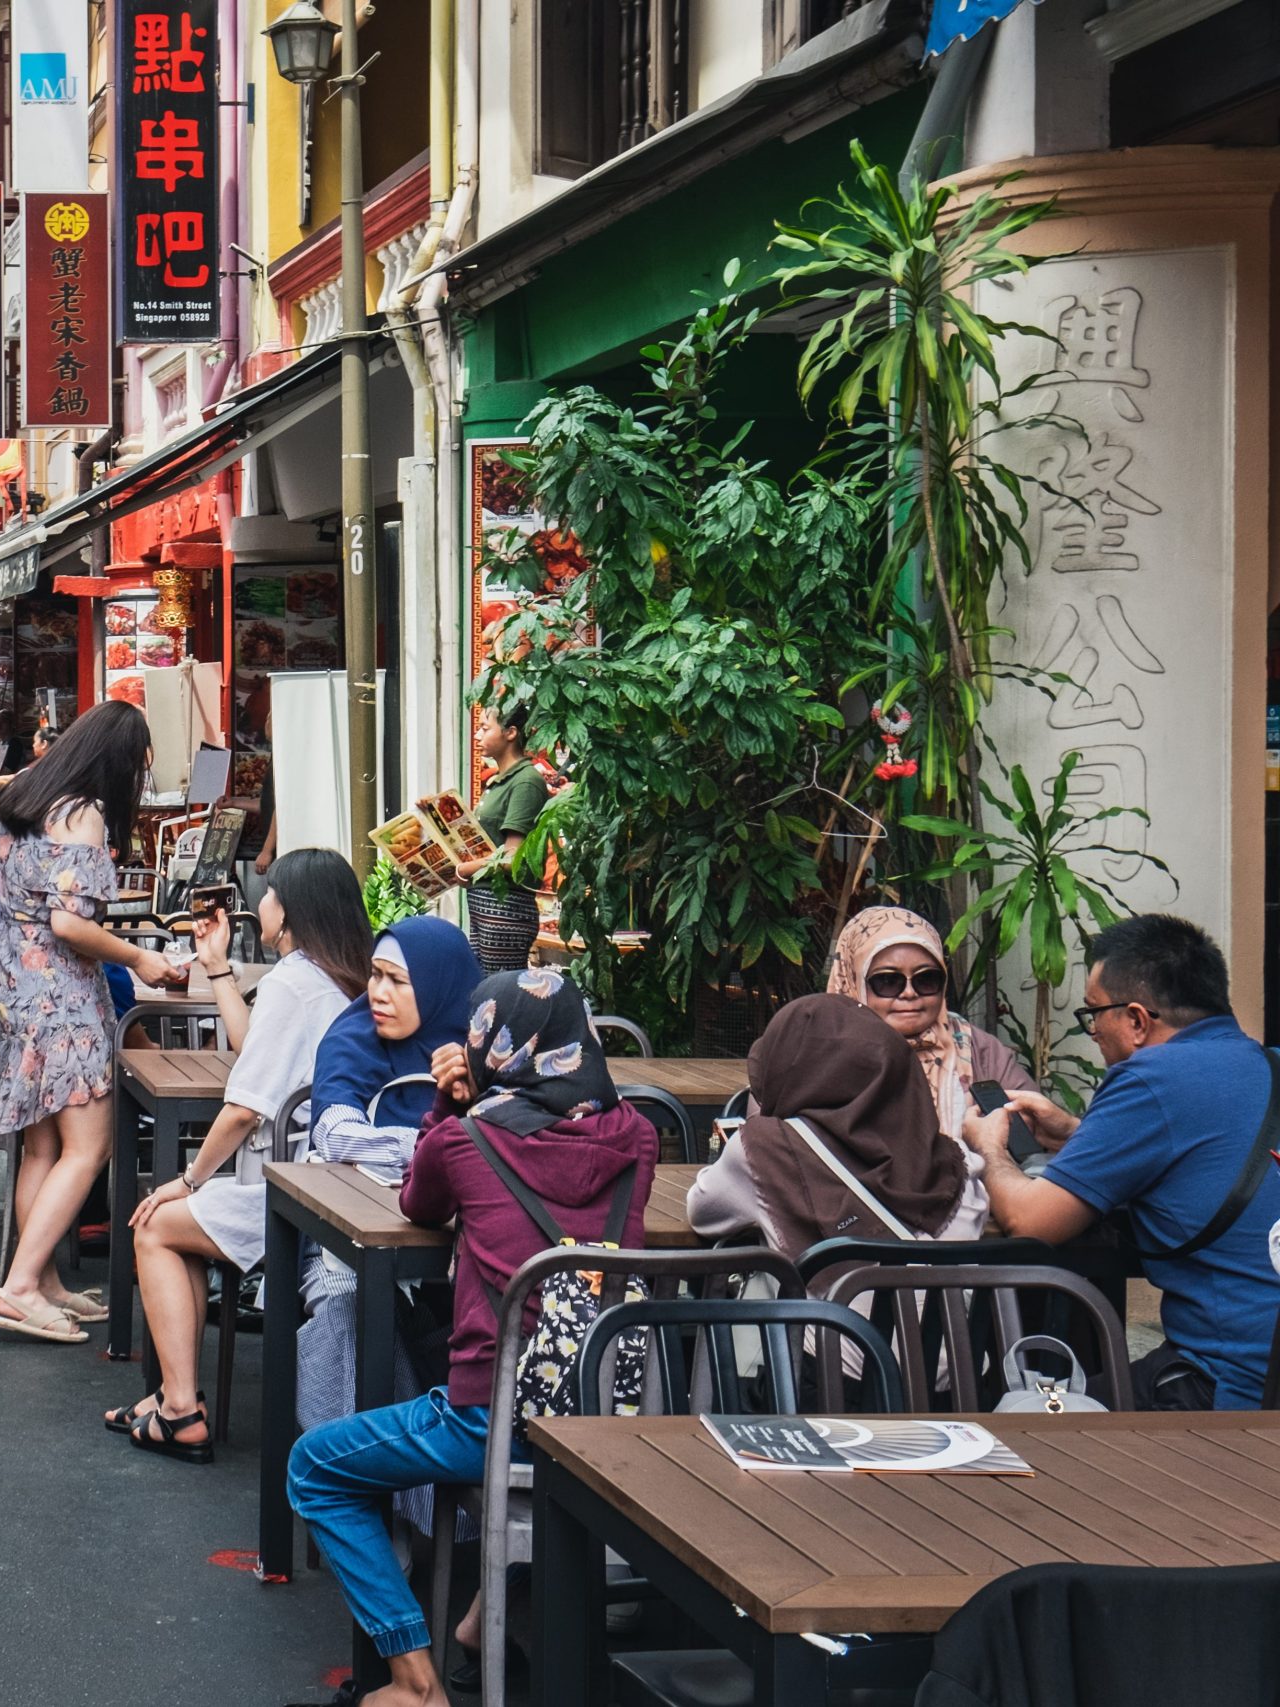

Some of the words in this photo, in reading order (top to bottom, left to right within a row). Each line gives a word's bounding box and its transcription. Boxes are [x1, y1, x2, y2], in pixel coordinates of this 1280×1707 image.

[133, 12, 209, 288] 點串吧
[133, 301, 157, 310] No.14
[160, 301, 183, 310] Smith
[186, 301, 212, 310] Street
[135, 313, 177, 324] Singapore
[180, 313, 210, 322] 058928
[350, 524, 364, 575] 20
